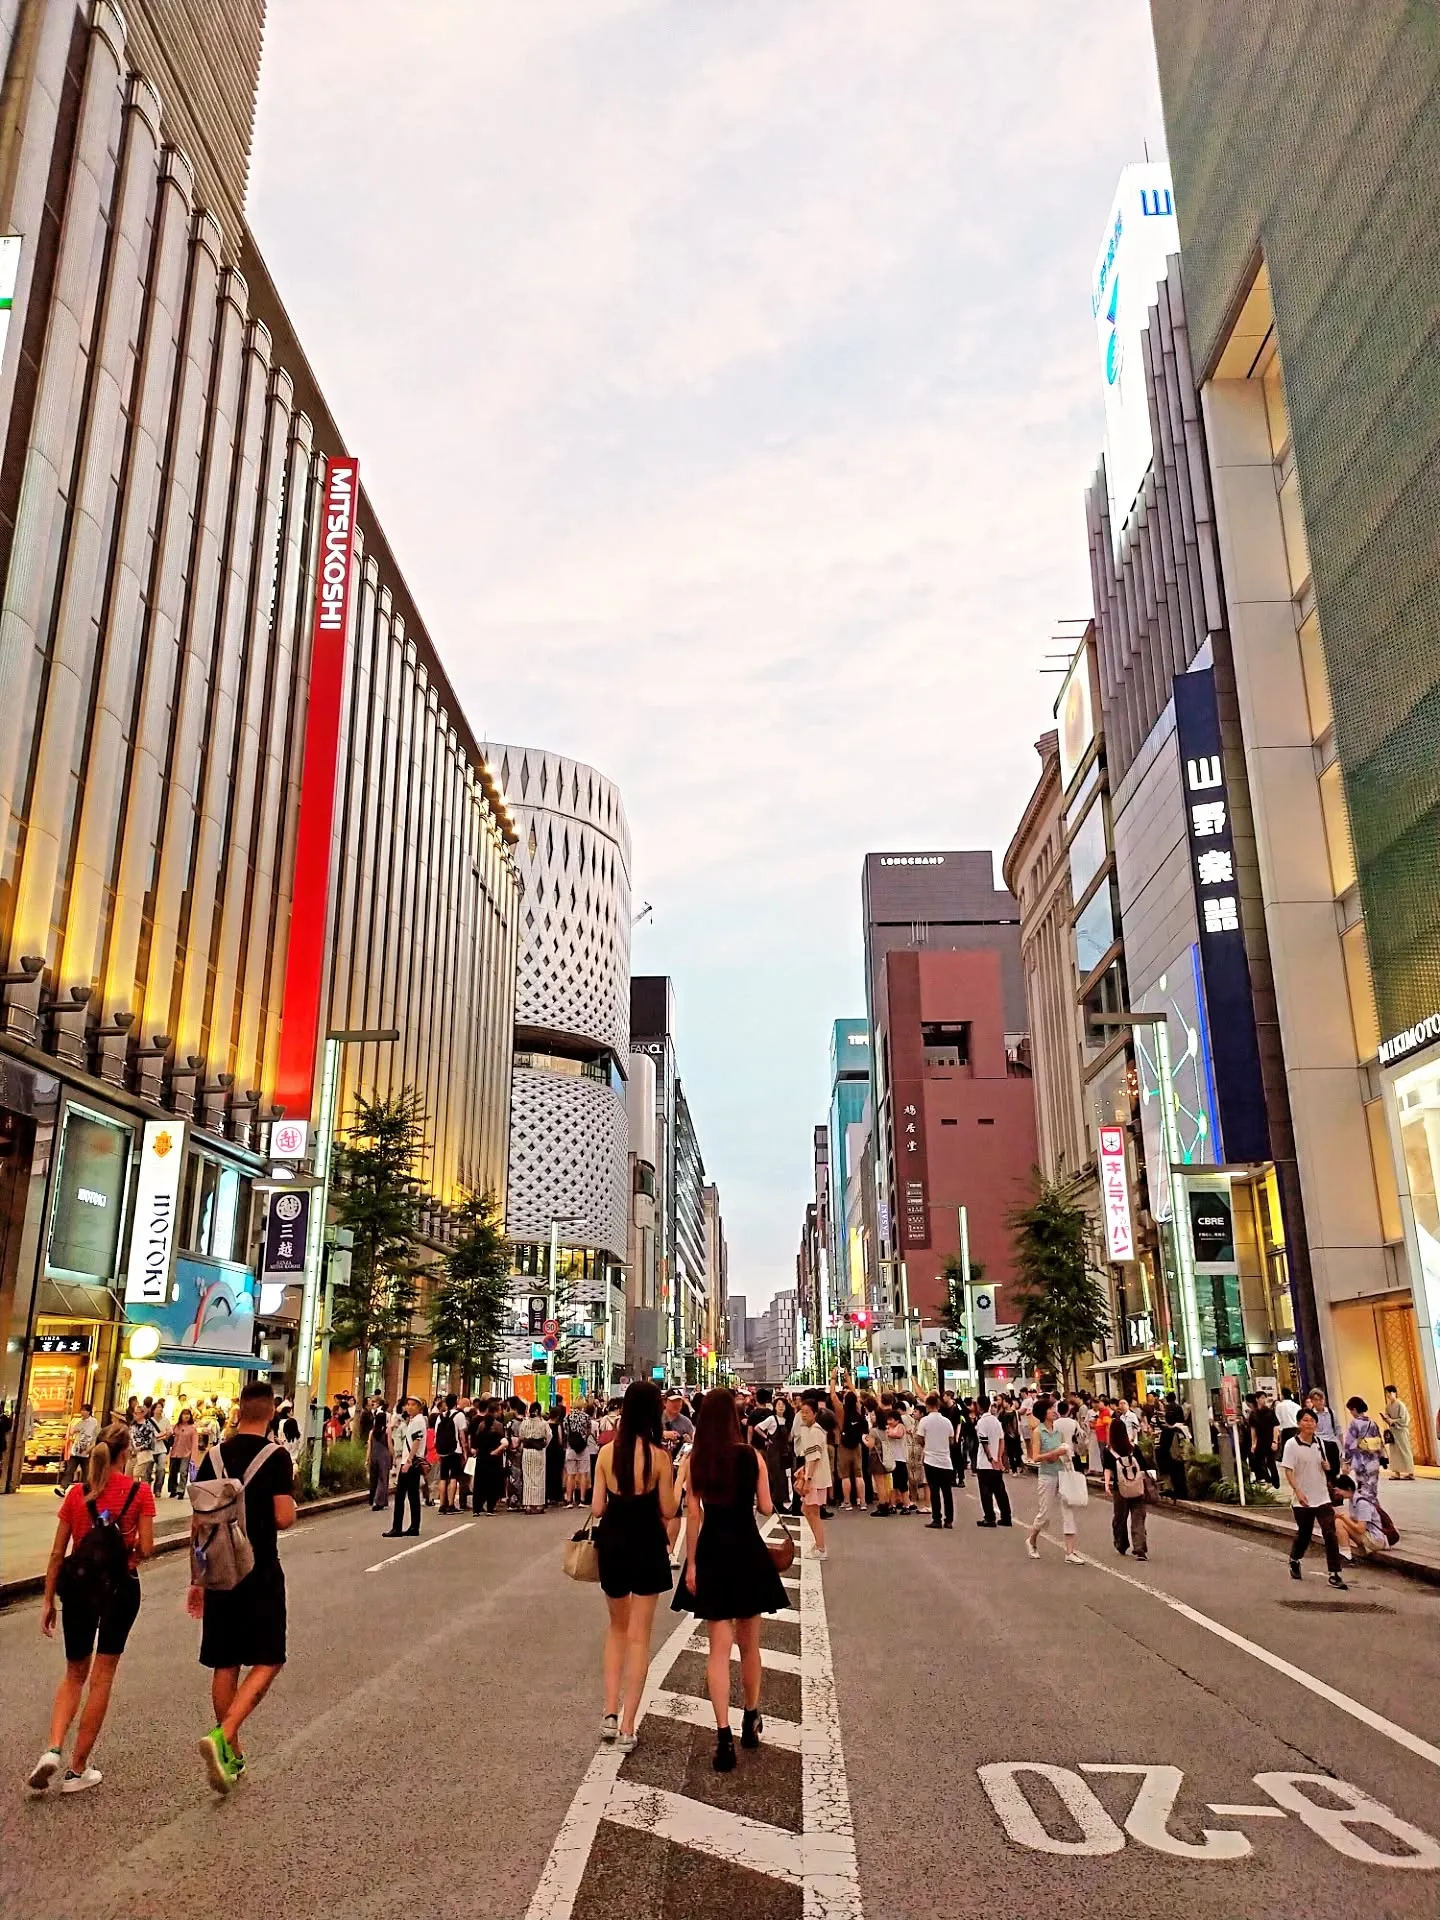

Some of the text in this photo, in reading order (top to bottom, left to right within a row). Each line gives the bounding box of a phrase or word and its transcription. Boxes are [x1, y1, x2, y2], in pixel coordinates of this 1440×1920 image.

[319, 468, 353, 630] MITSUKOSHI
[1186, 754, 1240, 933] 山野楽器
[880, 856, 945, 866] LONGCHAMP
[630, 1043, 664, 1054] FANCL
[1378, 1013, 1440, 1064] MIKIMOTO
[881, 1204, 889, 1236] TASAKI
[1106, 1161, 1130, 1254] キムラヤのパン
[1197, 1217, 1225, 1226] CBRE
[143, 1194, 171, 1297] MOTOKI
[277, 1223, 294, 1258] 三越
[546, 1323, 555, 1331] 50
[41, 1341, 82, 1352] モトキ
[32, 1387, 66, 1401] SALE
